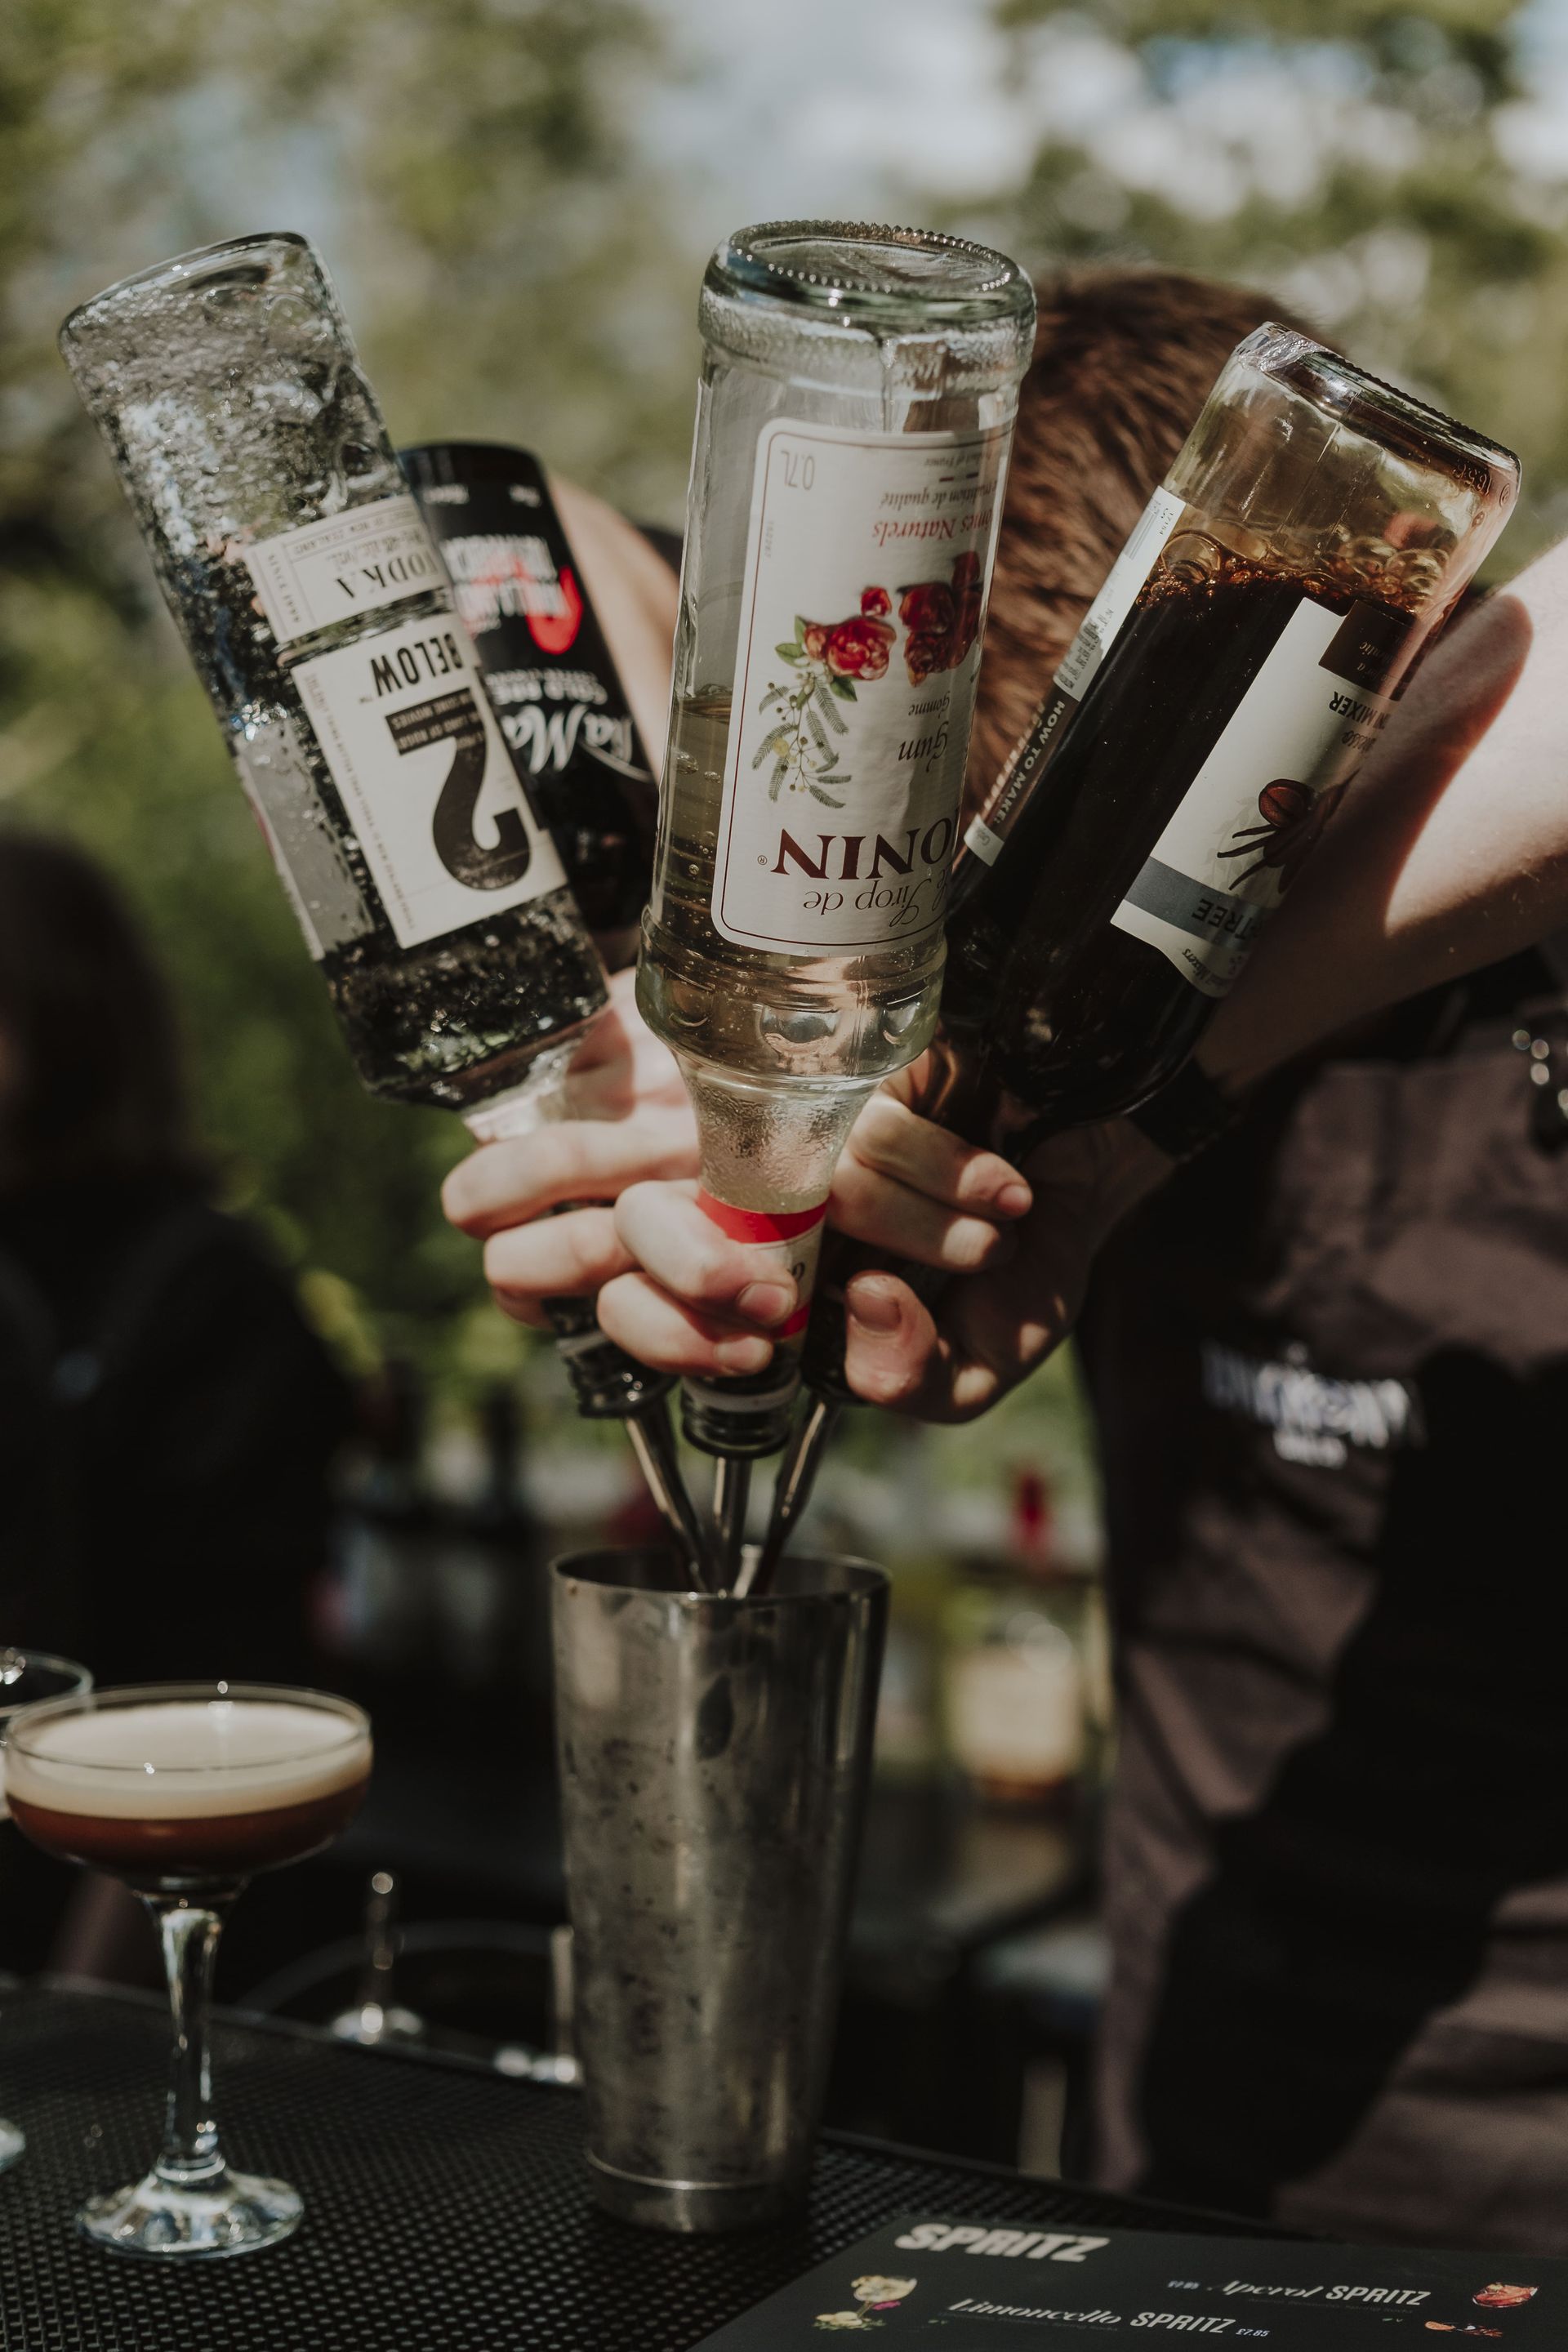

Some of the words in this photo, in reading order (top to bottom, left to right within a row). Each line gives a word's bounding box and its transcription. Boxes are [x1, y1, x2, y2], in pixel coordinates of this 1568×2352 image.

[781, 450, 813, 489] 0.7L
[879, 486, 929, 507] qualité
[931, 492, 947, 509] de
[871, 518, 956, 546] Naturels
[335, 550, 439, 599] VODKA
[369, 632, 461, 697] BELOW
[908, 692, 949, 718] Gomme
[1036, 700, 1065, 743] HOW
[1327, 690, 1377, 724] MIXER
[898, 721, 949, 772] Gum
[1022, 747, 1040, 769] TO
[385, 687, 531, 889] 2
[994, 771, 1025, 823] MAKE:
[771, 818, 950, 880] ONIN
[803, 889, 844, 915] de
[854, 880, 930, 928] Sirop
[1181, 947, 1209, 978] Mixers
[894, 2224, 1110, 2261] SPRITZ
[1205, 2280, 1324, 2297] Aperol
[1325, 2285, 1430, 2305] SPRITZ
[947, 2297, 1122, 2325] Limoncello
[1129, 2313, 1235, 2332] SPRITZ
